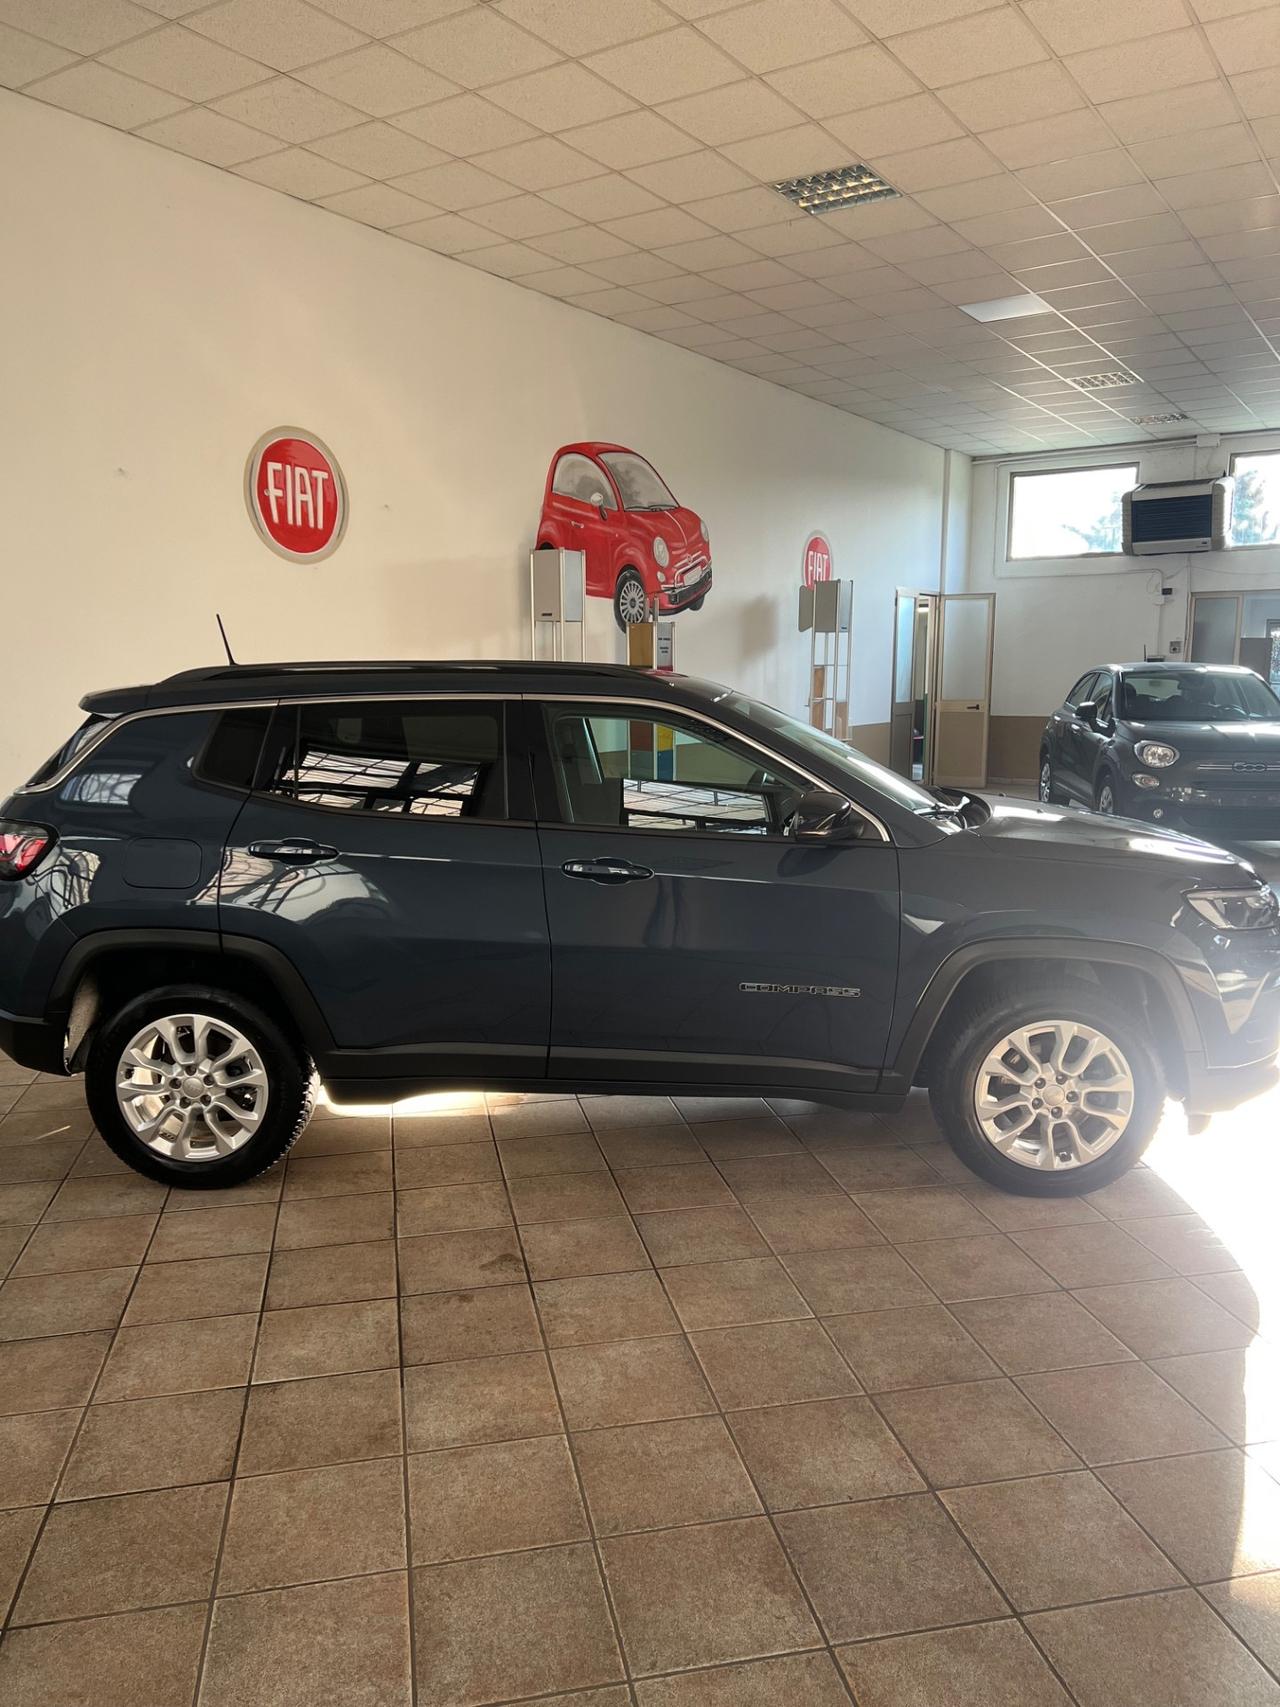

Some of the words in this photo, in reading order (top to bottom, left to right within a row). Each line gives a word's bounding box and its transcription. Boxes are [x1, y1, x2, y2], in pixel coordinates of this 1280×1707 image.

[265, 461, 329, 530] FIAT
[808, 550, 829, 586] FIAT
[739, 982, 861, 998] COMPASS
